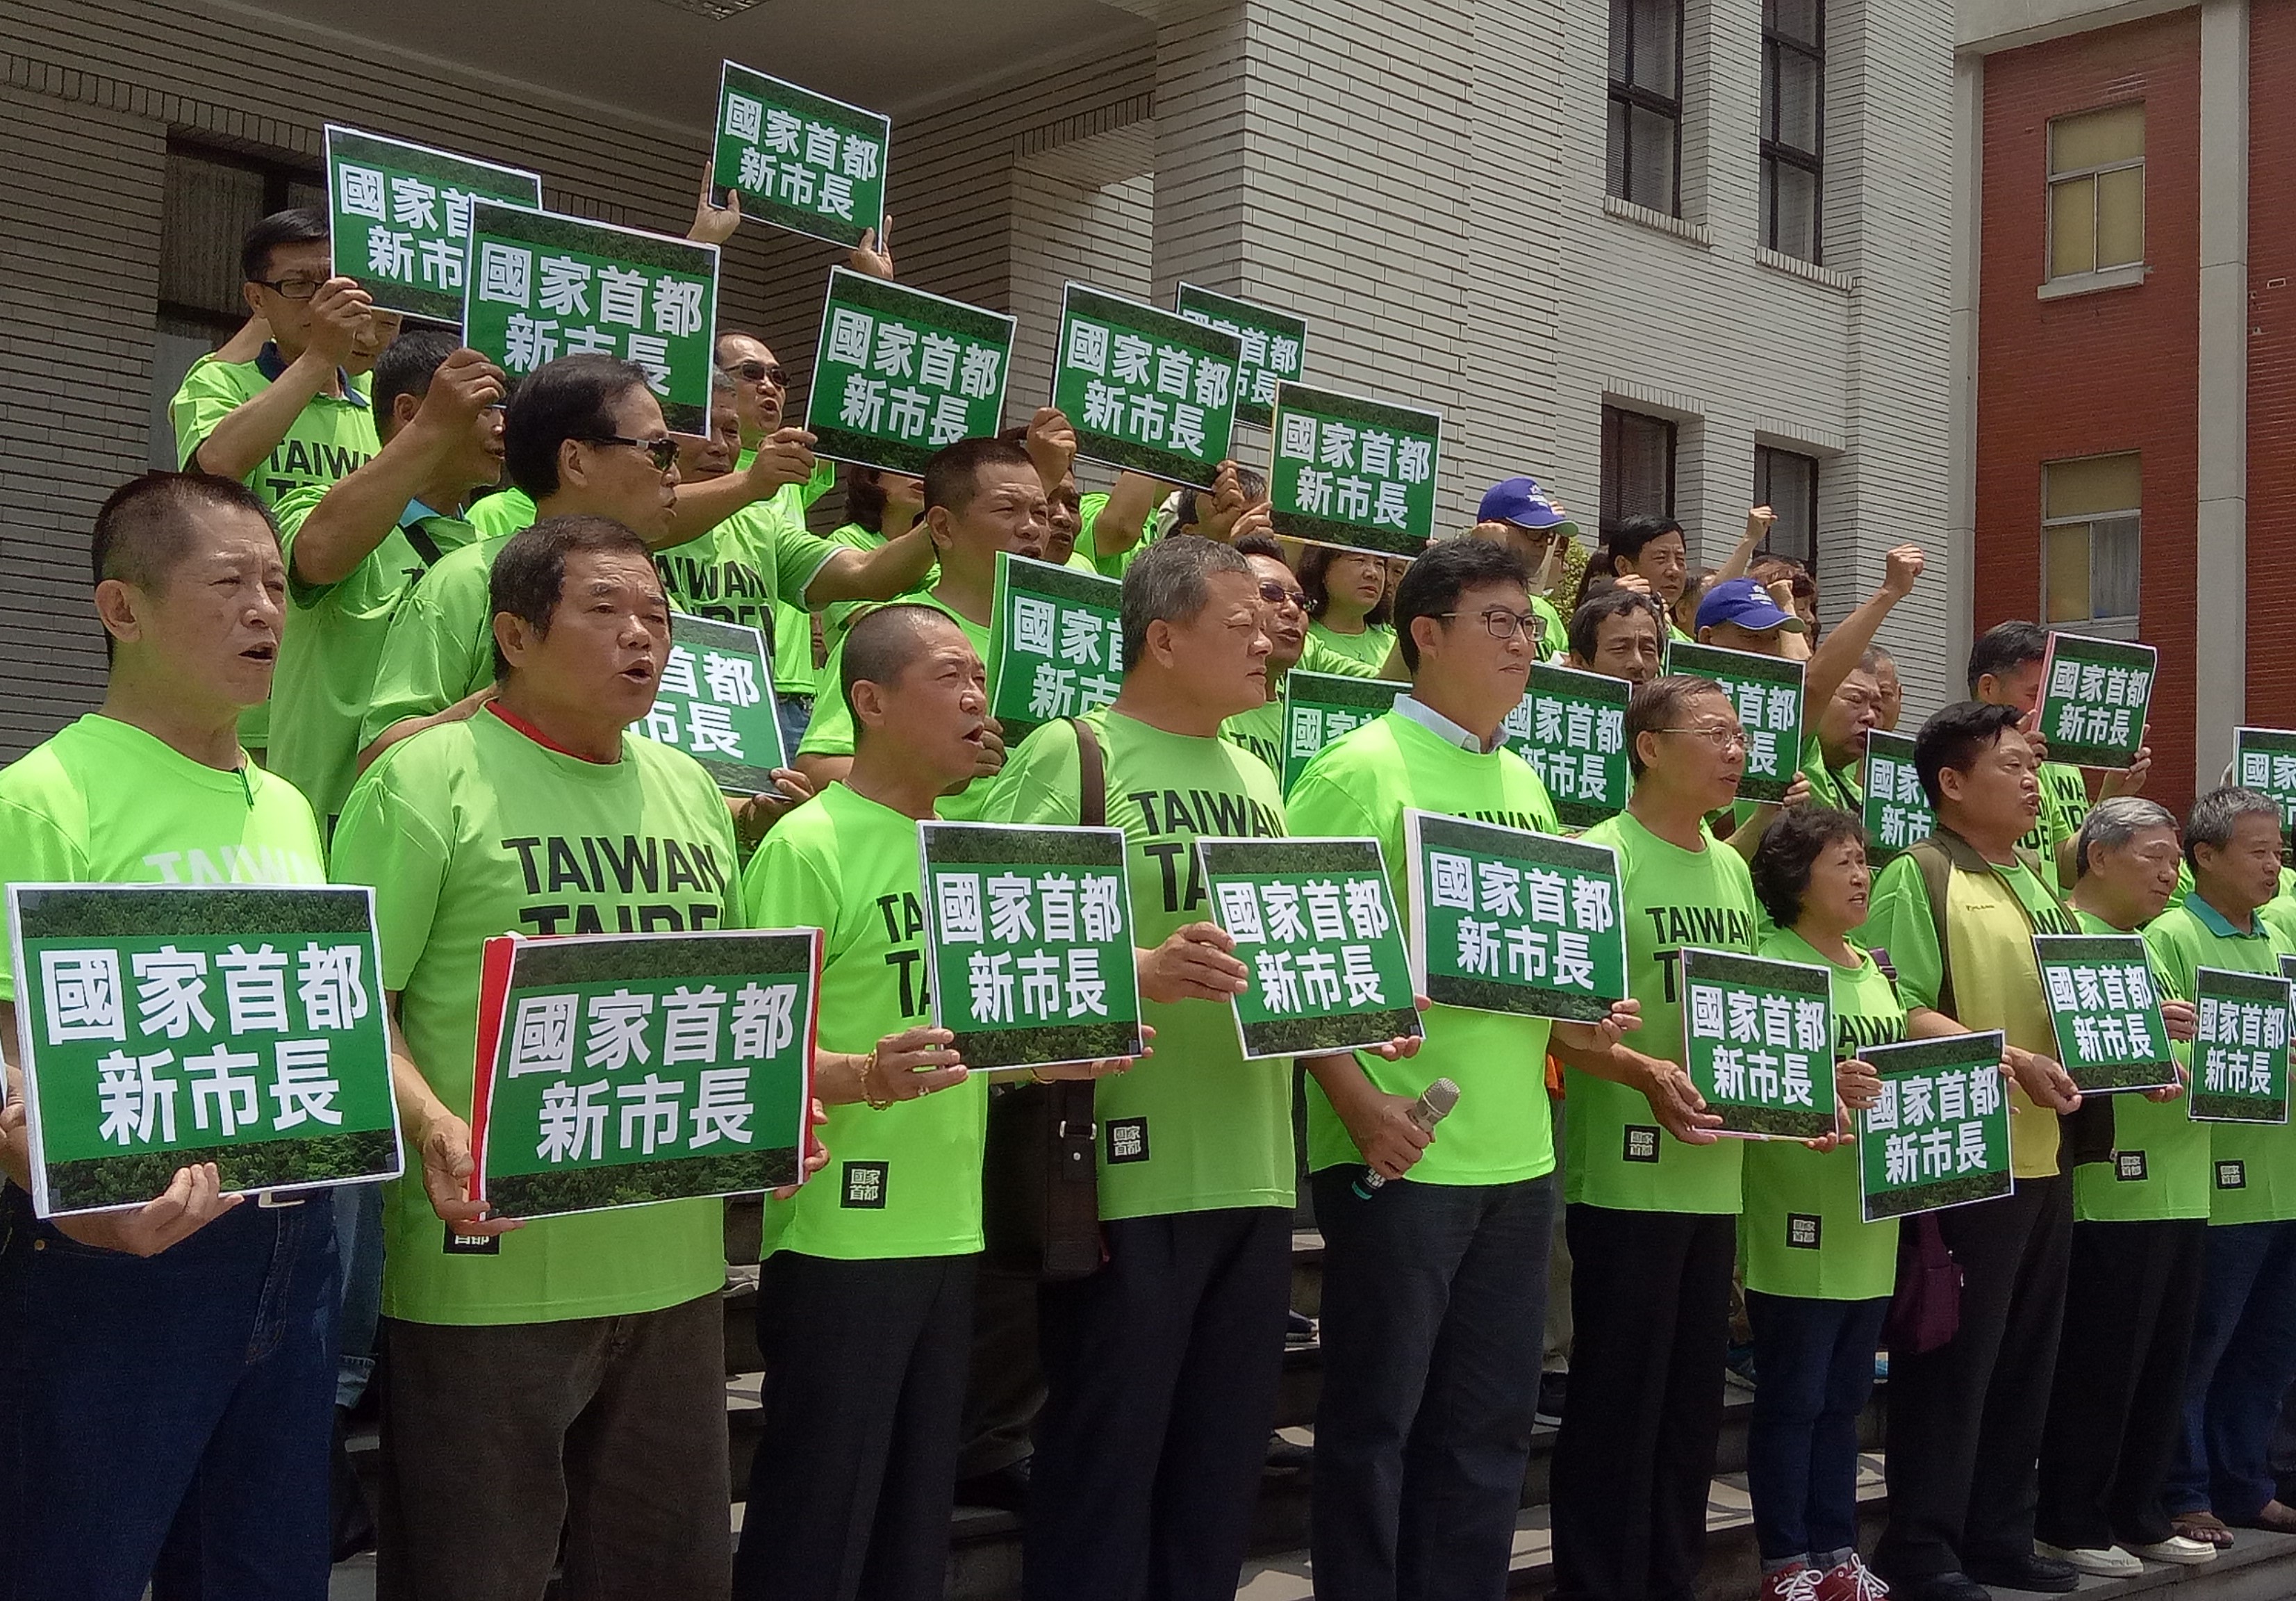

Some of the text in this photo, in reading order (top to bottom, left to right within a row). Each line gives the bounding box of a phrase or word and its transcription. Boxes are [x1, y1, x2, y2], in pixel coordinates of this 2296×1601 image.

[725, 92, 879, 181] 國家首都
[338, 163, 470, 238] 國家首
[738, 147, 854, 222] 新市長
[367, 225, 464, 290] 新市
[479, 241, 704, 338] 國家首都
[827, 307, 1001, 400] 國家首都
[1066, 319, 1232, 409] 國家首都
[840, 372, 969, 445] 新市長
[1083, 379, 1206, 457] 新市長
[1280, 412, 1432, 484] 國家首都
[1295, 466, 1409, 529] 新市長
[1014, 596, 1123, 673] 國家
[659, 644, 761, 708] 首都
[1028, 662, 1121, 719] 新市
[2049, 660, 2149, 708] 國家首都
[628, 700, 744, 760] 市長
[1504, 693, 1624, 755] 國家首都
[2056, 703, 2131, 748] 新市長
[1127, 789, 1285, 838] TAIWAN
[1869, 757, 1930, 808] 國家
[1880, 804, 1932, 847] 新市
[502, 835, 725, 896] TAIWAN
[1430, 851, 1614, 933] 國家首都
[936, 871, 1122, 945] 國家首都
[1216, 878, 1389, 944] 國家首都
[1645, 906, 1752, 946] TAIWAN
[968, 948, 1108, 1024] 新市長
[1255, 944, 1385, 1014] 新市長
[1457, 916, 1594, 990] 新市長
[40, 942, 368, 1045] 國家首都
[1690, 984, 1826, 1053] 國家首都
[2045, 964, 2152, 1013] 國家首都
[508, 981, 798, 1078] 國家首都
[2072, 1013, 2155, 1062] 新市長
[2197, 997, 2286, 1050] 國家首都
[97, 1039, 342, 1145] 新市長
[1712, 1044, 1813, 1107] 新市長
[1866, 1066, 2000, 1133] 國家首都
[2205, 1046, 2272, 1095] 新市長
[536, 1067, 754, 1163] 新市長
[1885, 1120, 1987, 1185] 新市長
[849, 1185, 879, 1201] 首都
